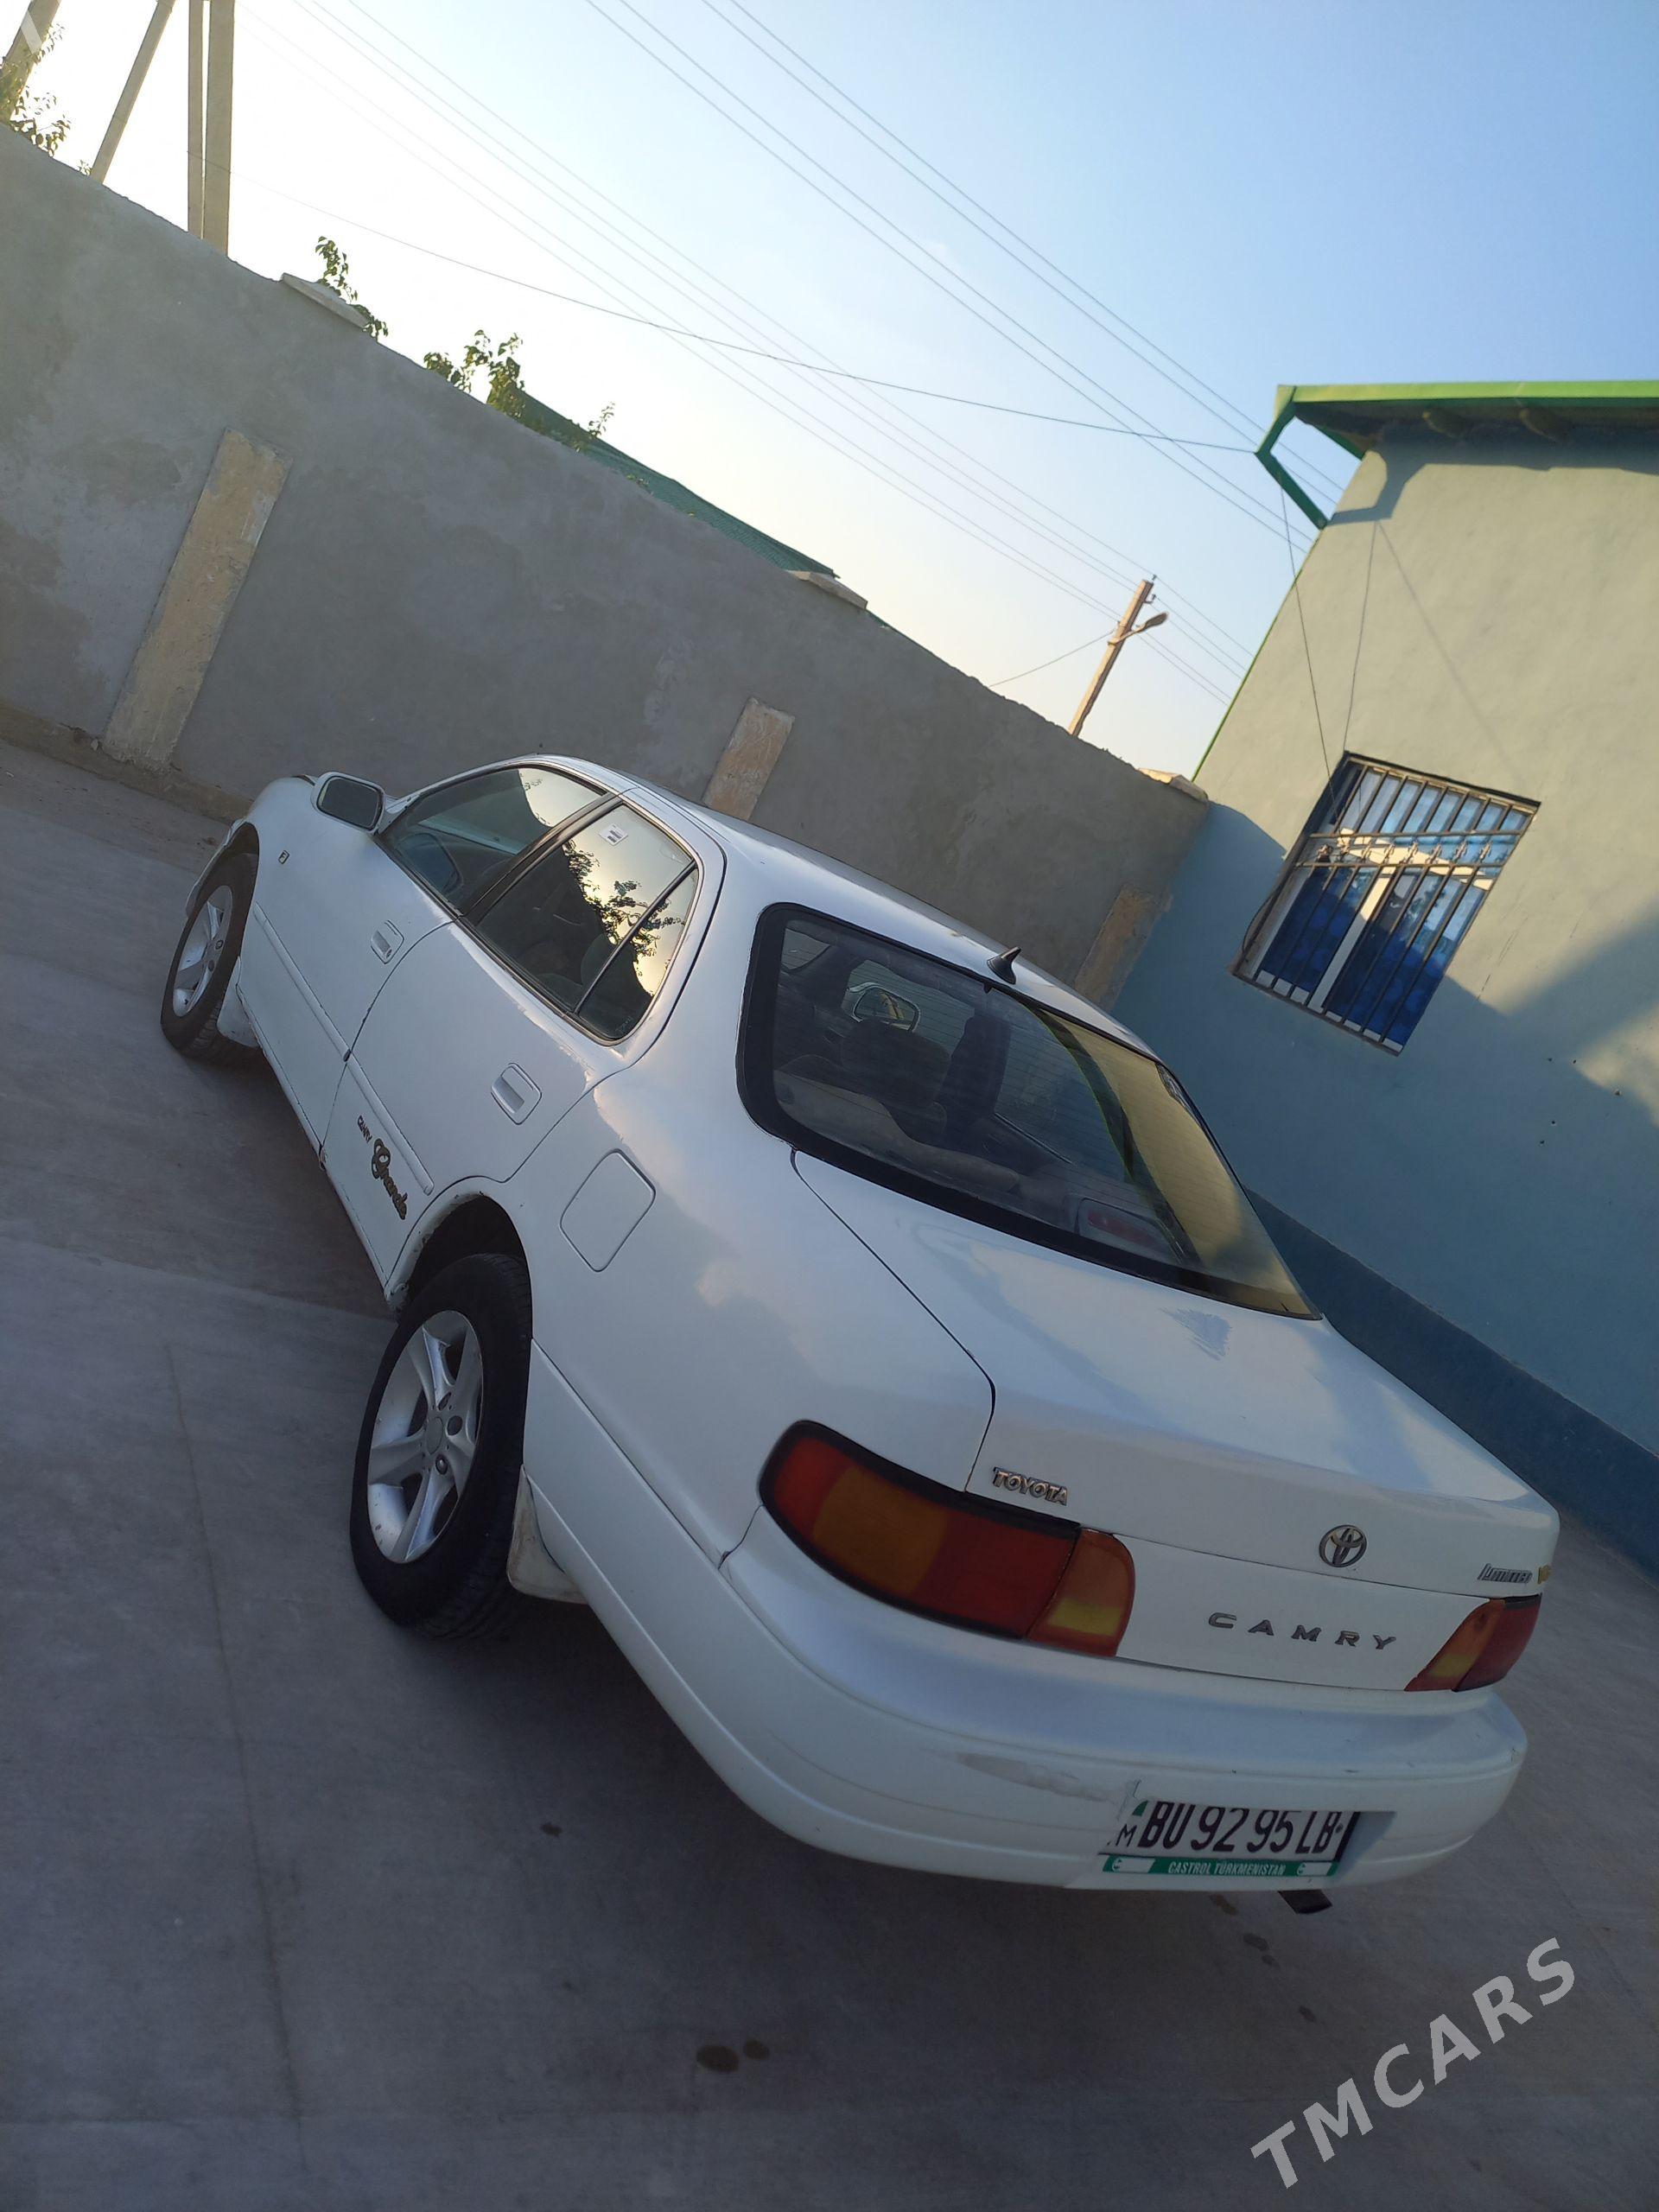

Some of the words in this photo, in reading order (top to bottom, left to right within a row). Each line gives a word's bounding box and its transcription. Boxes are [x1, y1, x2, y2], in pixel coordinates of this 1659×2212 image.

[992, 1466, 1068, 1506] TOYOTA
[1208, 1611, 1397, 1649] CAMRY
[1137, 1801, 1196, 1849] BU
[1191, 1806, 1250, 1852] 92
[1246, 1809, 1301, 1853] 95
